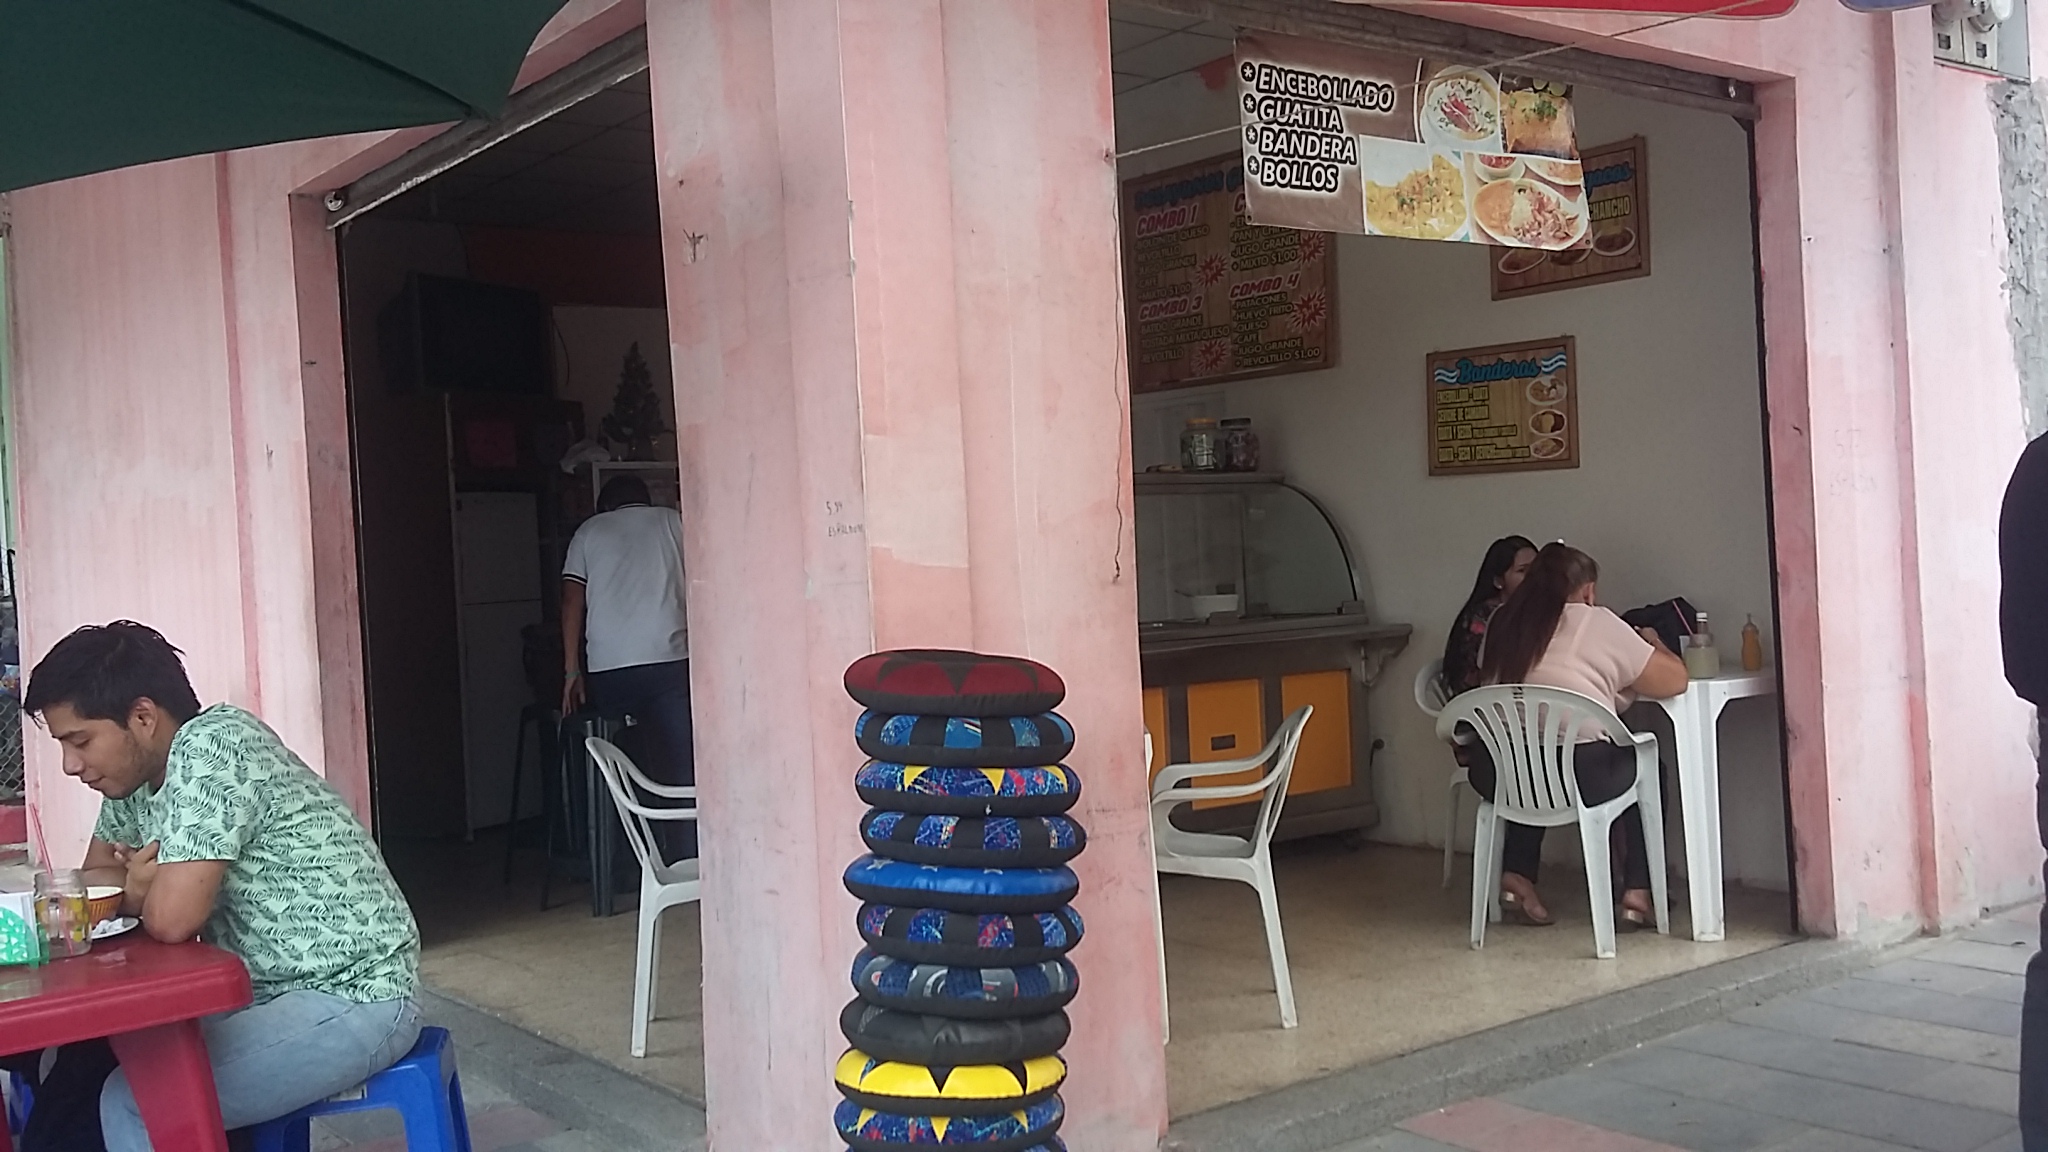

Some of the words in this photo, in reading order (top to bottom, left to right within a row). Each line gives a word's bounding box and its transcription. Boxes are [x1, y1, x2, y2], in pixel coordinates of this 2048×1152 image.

[1257, 66, 1393, 110] ENCEBOLLADO
[1258, 97, 1343, 131] GUATITA
[1260, 129, 1356, 163] BANDERA
[1261, 160, 1338, 190] BOLLOS
[1136, 206, 1187, 237] COMBO
[1188, 203, 1199, 225] 1
[1180, 226, 1209, 240] QUESO
[1262, 234, 1300, 250] GRANDE
[1240, 256, 1268, 270] MIXTO
[1229, 275, 1283, 299] COMBO
[1285, 271, 1300, 288] 4
[1139, 297, 1188, 321] COMBO
[1192, 295, 1204, 311] 3
[1269, 304, 1293, 316] FRITO
[1265, 338, 1302, 351] GRANDE
[1243, 352, 1291, 366] REVOLTILLO
[1456, 357, 1541, 384] Banderas
